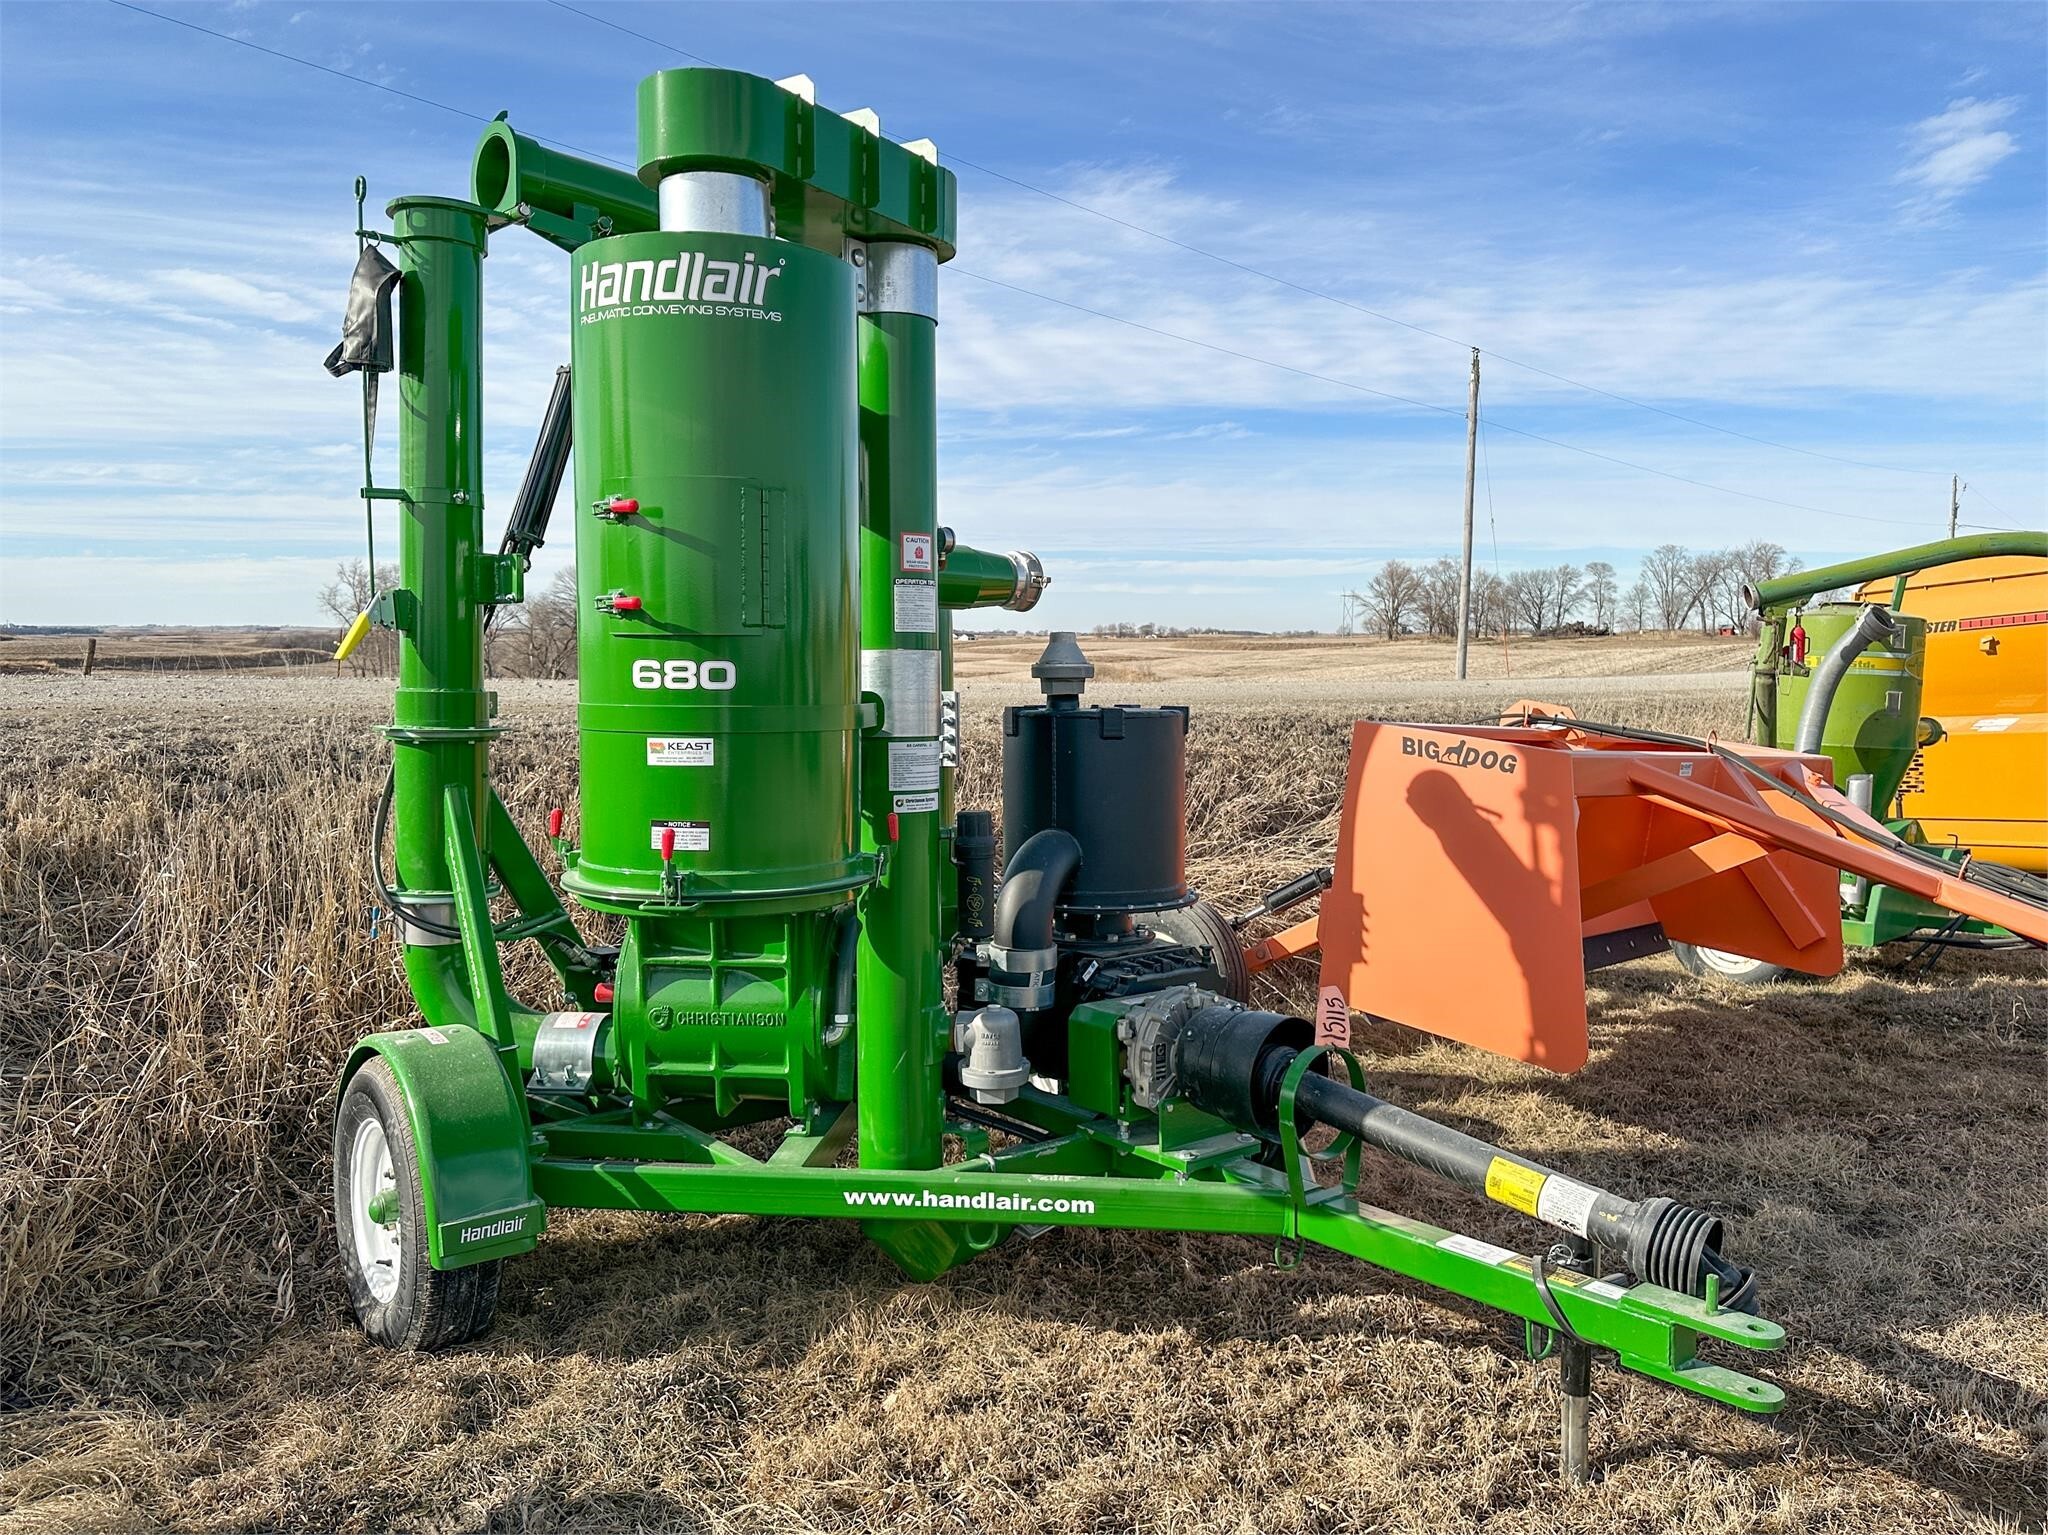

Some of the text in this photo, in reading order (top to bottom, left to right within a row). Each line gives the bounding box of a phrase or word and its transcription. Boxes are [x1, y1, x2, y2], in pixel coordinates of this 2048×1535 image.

[580, 251, 782, 313] Handlair
[580, 304, 783, 325] PNEUMATIC CONVEYING SYSTEMS
[905, 536, 930, 544] CAUTION
[632, 659, 737, 690] 680
[667, 742, 712, 751] KEAST
[1402, 736, 1518, 774] BIG DOG
[676, 1010, 786, 1028] CHRISTIANSON
[1320, 997, 1346, 1041] 15115
[843, 1190, 1096, 1214] www.handlair.com
[460, 1215, 527, 1244] Handlair
